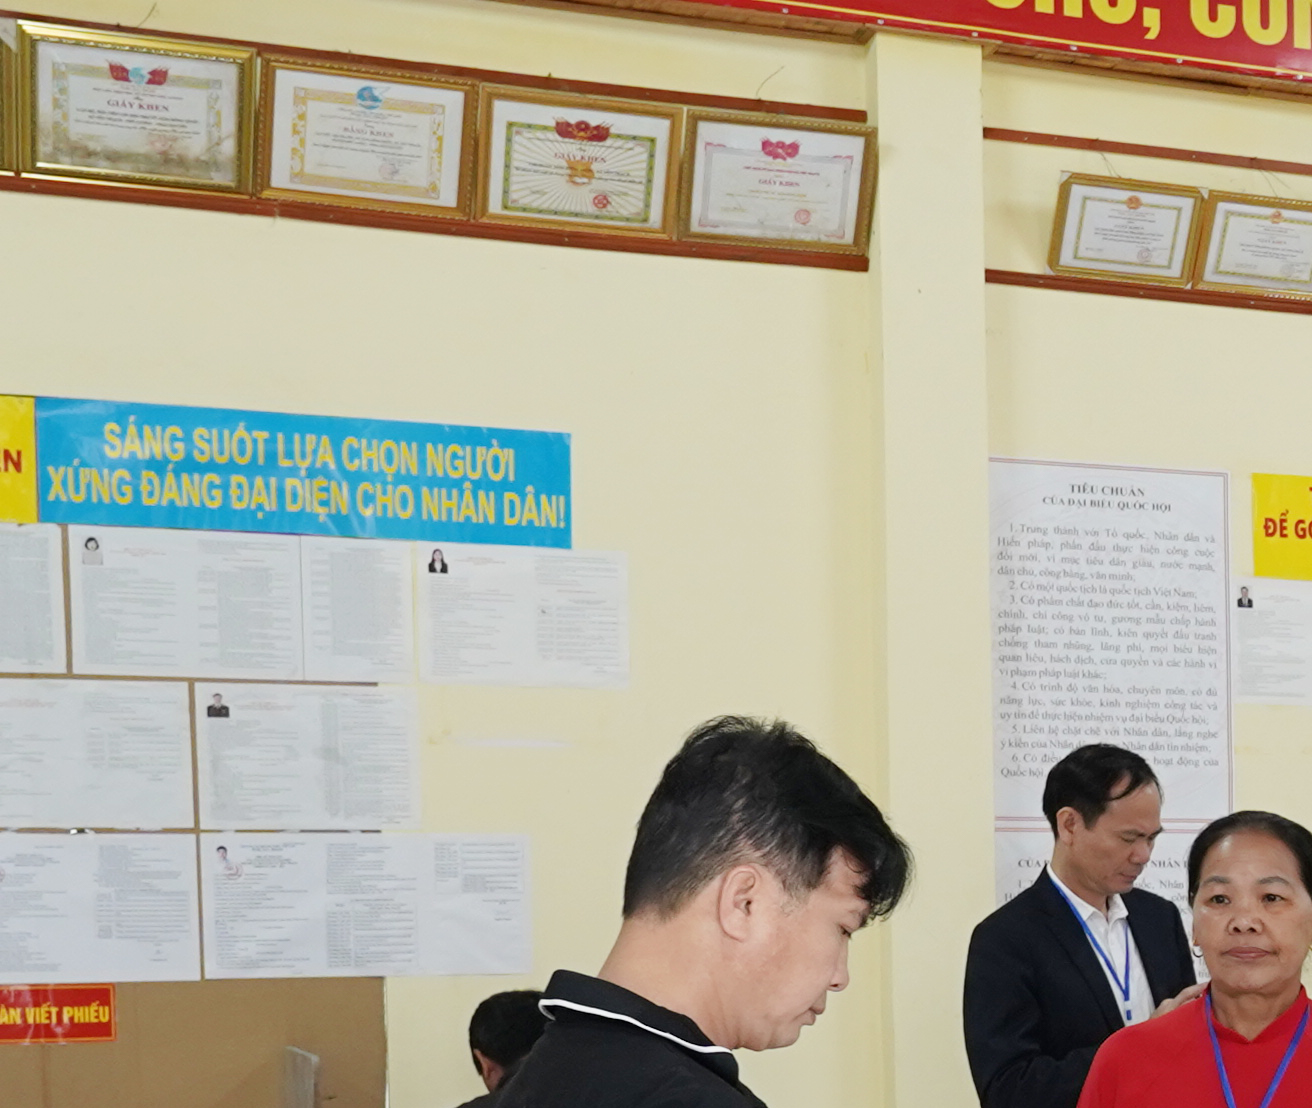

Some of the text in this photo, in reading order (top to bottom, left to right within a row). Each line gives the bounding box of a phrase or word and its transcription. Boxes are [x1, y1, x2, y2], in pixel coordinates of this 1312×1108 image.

[104, 416, 515, 482] SÁNG SUỐT LỰA CHỌN NGƯỜI
[47, 457, 566, 529] XỨNG ĐÁNG ĐẠI DIỆN CHO NHÂN DÂN!
[1264, 510, 1288, 538] ĐỂ
[25, 1002, 59, 1024] VIẾT
[62, 1000, 109, 1023] PHIẾU
